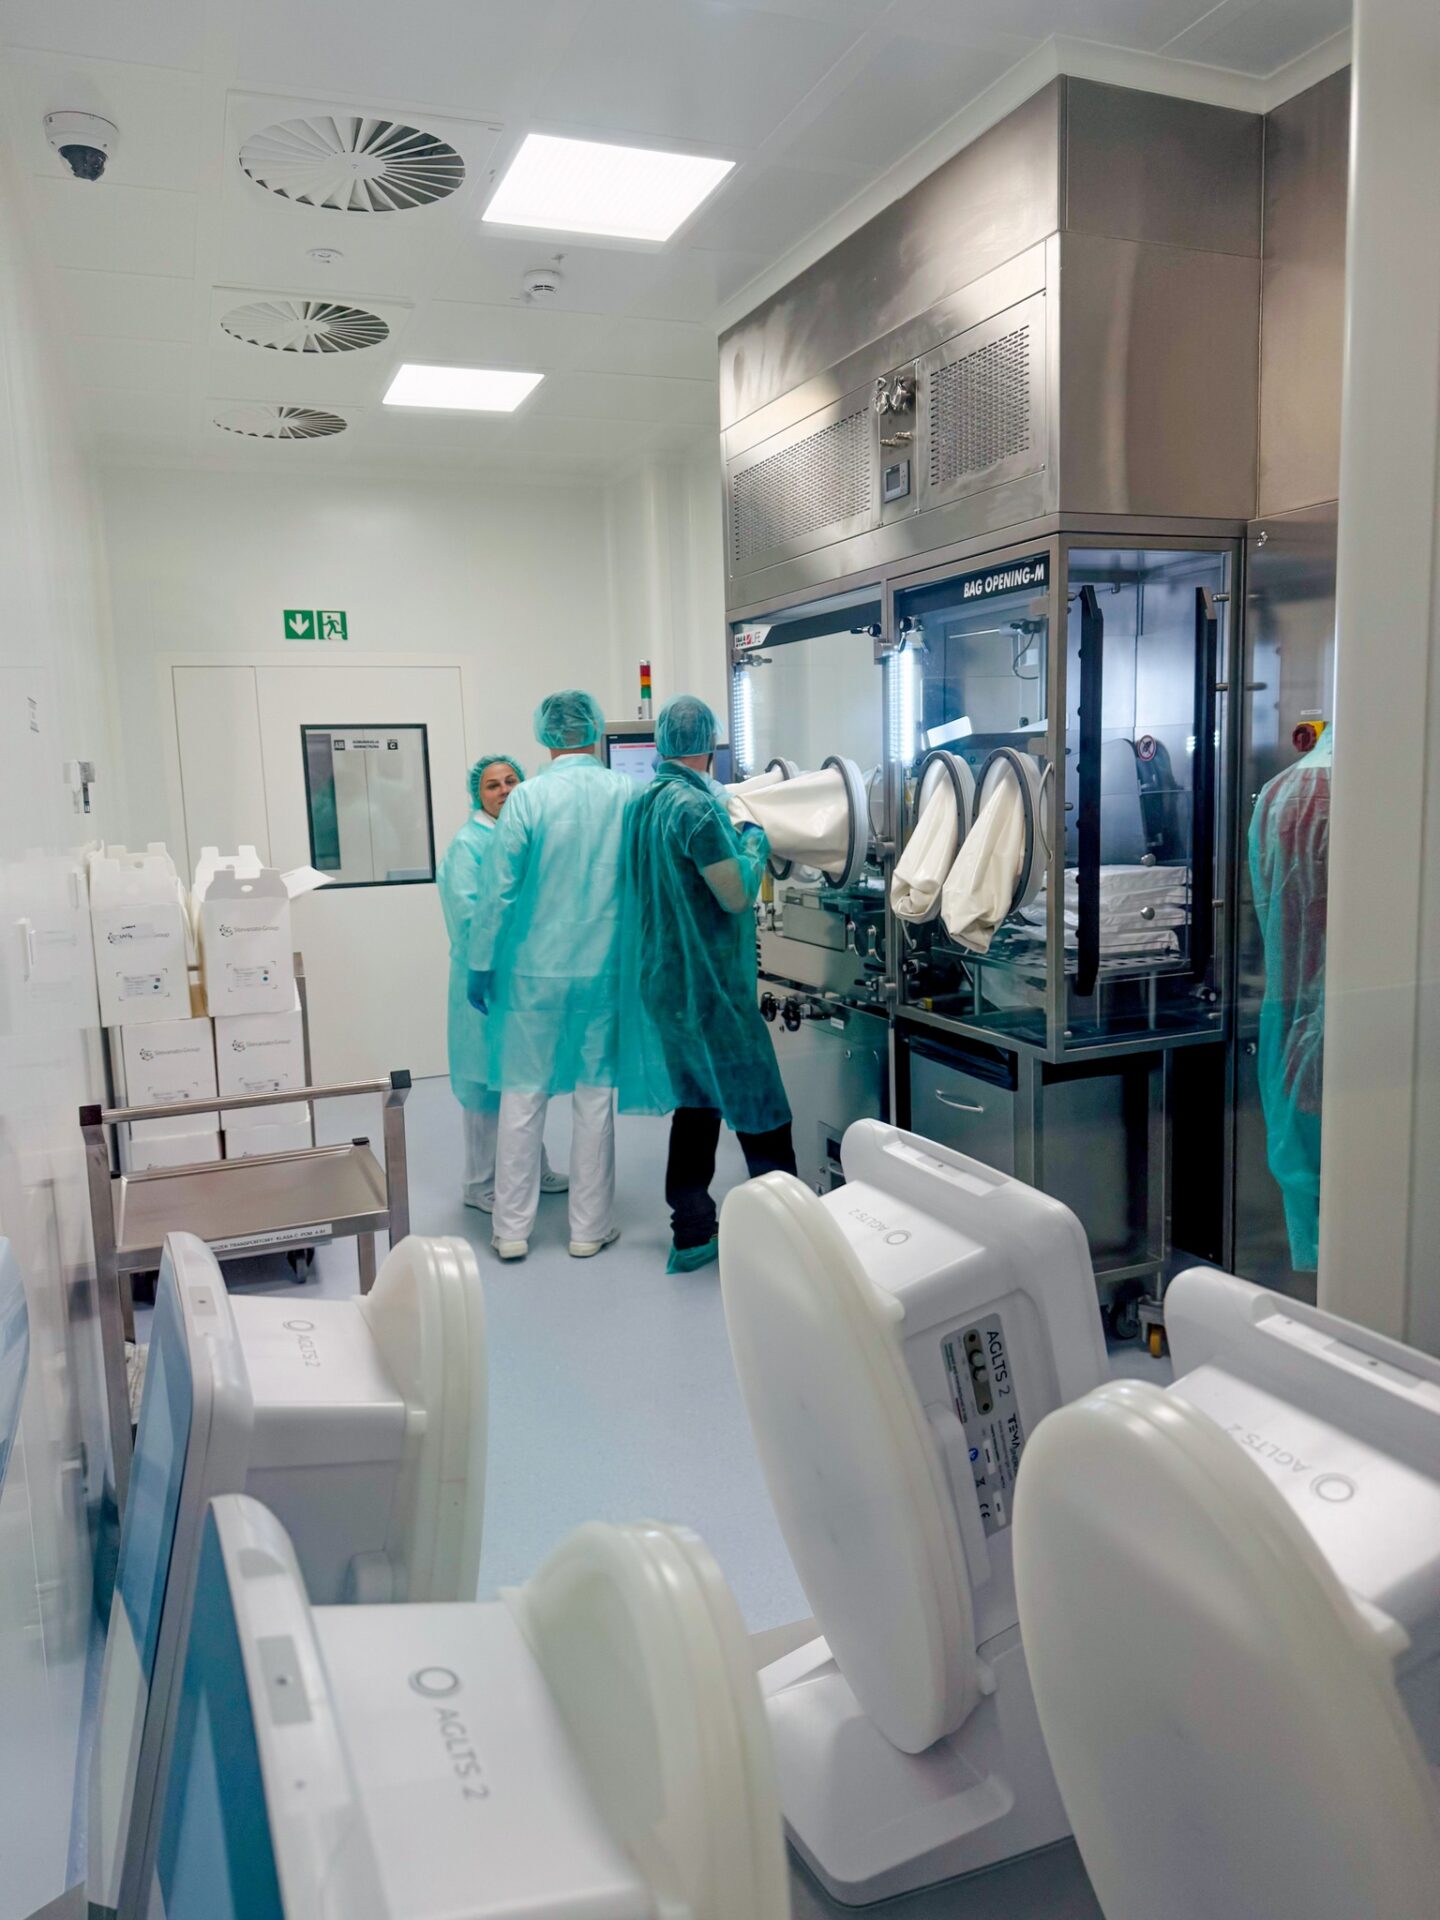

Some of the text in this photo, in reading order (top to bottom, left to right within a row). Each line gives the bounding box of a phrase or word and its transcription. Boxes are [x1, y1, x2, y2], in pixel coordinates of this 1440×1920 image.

[963, 563, 1045, 598] BAG OPENING-M
[986, 1331, 1011, 1398] AGLTS 2
[433, 1706, 491, 1801] AGLTS 2
